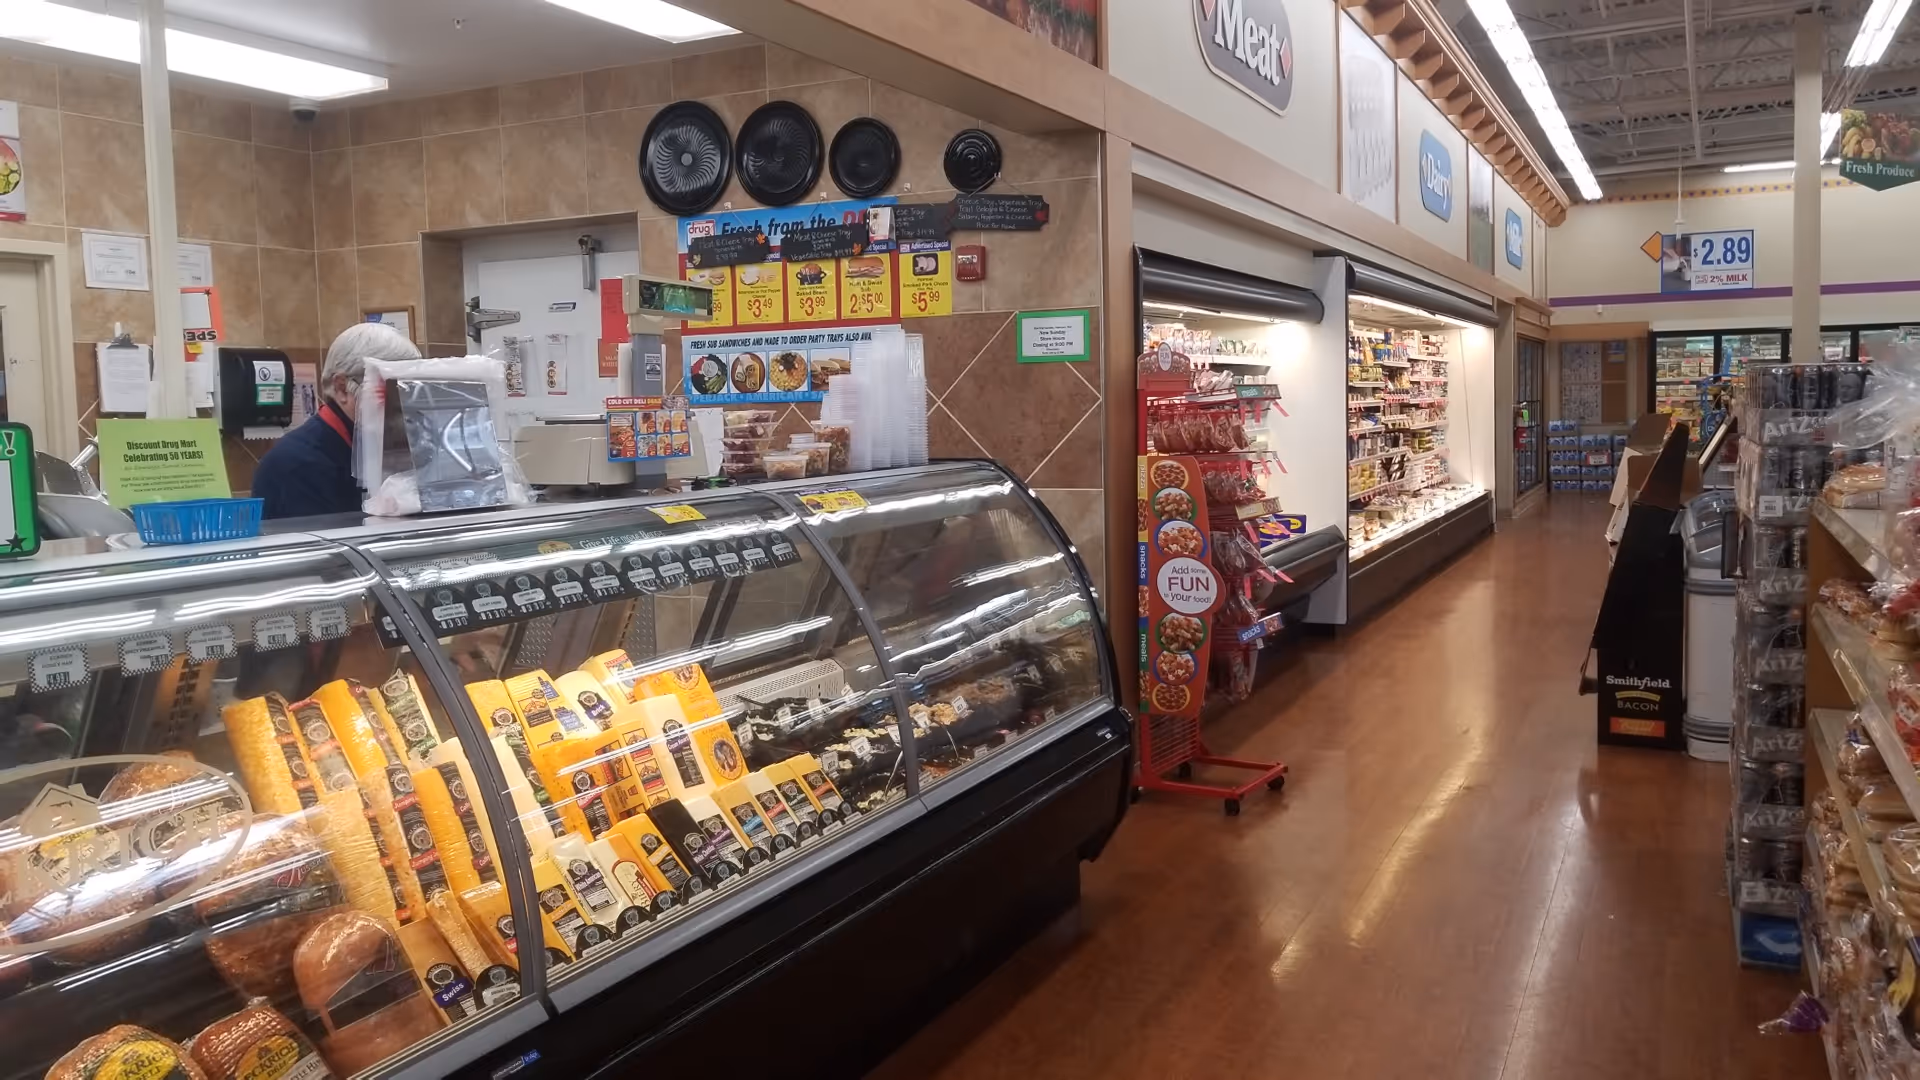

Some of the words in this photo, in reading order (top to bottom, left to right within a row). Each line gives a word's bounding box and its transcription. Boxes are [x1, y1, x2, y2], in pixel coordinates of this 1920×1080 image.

[1213, 0, 1281, 86] Meat
[1846, 161, 1873, 175] Fresh
[1875, 162, 1915, 178] Produce
[1425, 151, 1451, 209] Dairy
[688, 223, 711, 235] drug
[721, 219, 762, 236] Fresh
[767, 217, 805, 238] from
[809, 213, 837, 229] the
[933, 240, 949, 250] Special
[1701, 236, 1751, 266] 2.89
[1710, 275, 1724, 284] 2%
[1726, 273, 1748, 283] MILK
[184, 329, 217, 342] SPE
[690, 340, 707, 350] FRESH
[707, 339, 718, 349] SUB
[718, 338, 751, 348] SANDWICHES
[752, 336, 763, 346] AND
[764, 335, 779, 346] MADE
[780, 335, 788, 345] TO
[789, 334, 807, 345] ORDER
[808, 333, 826, 344] PARTY
[825, 332, 844, 343] TRAYS
[844, 331, 859, 342] ALSO
[126, 440, 161, 451] Discount
[161, 440, 180, 450] Drug
[180, 439, 198, 448] Mart
[123, 452, 169, 463] Celebrating
[169, 451, 179, 460] 50
[180, 450, 204, 460] YEARS!
[1137, 463, 1146, 490] pizza
[579, 538, 601, 550] Give
[601, 534, 619, 546] Life
[1139, 545, 1147, 580] snacks
[1171, 565, 1190, 575] Add
[1190, 567, 1207, 575] some
[1167, 576, 1210, 592] FUN
[1170, 592, 1192, 603] your
[1240, 625, 1262, 641] snacks
[1139, 632, 1147, 663] meals
[1606, 674, 1671, 689] Smithfield
[1617, 700, 1659, 711] BACON
[441, 982, 465, 1002] Swiss
